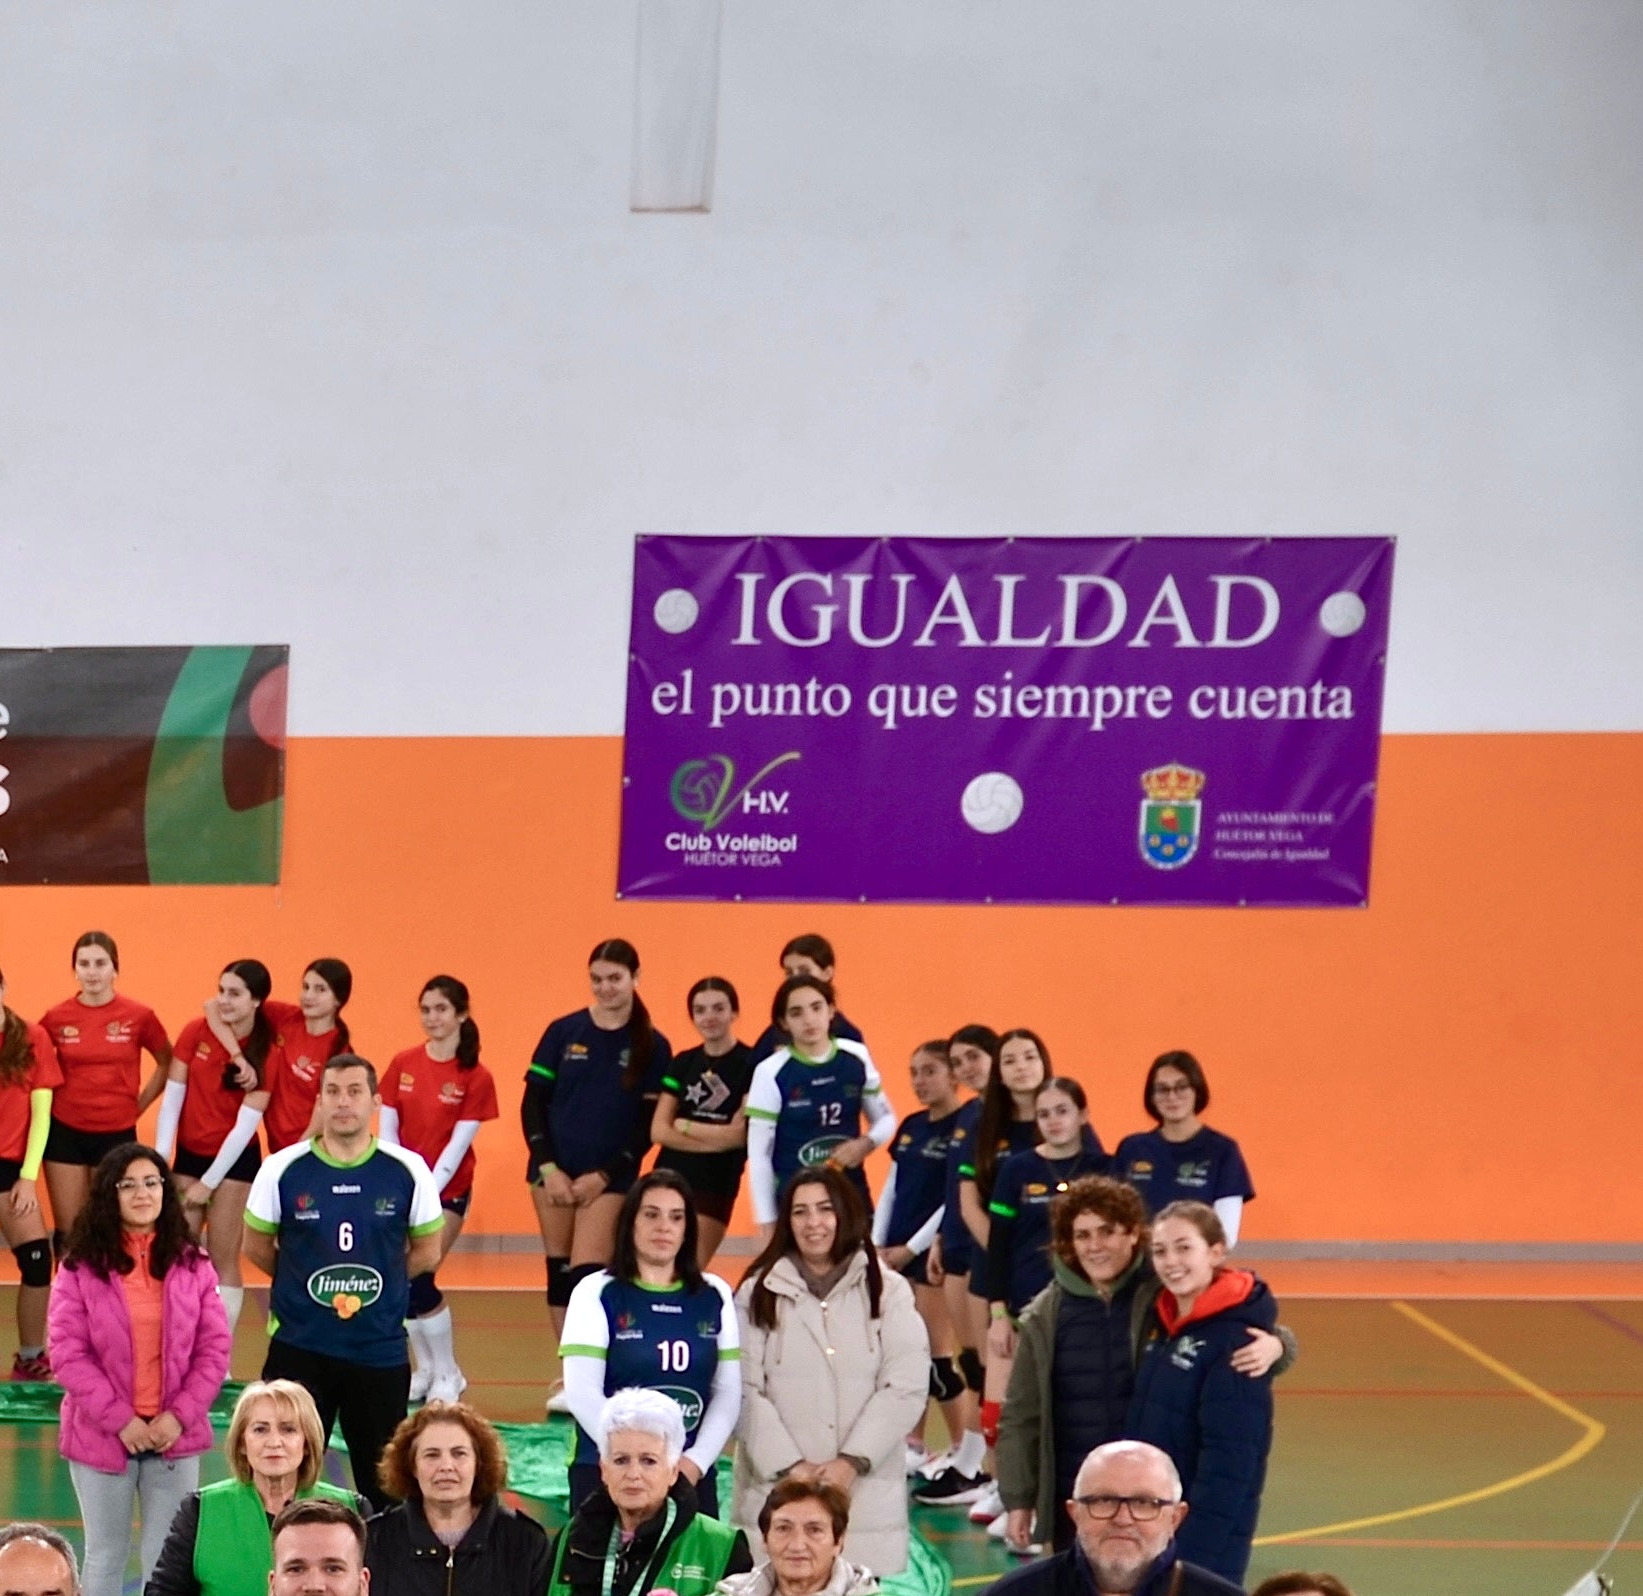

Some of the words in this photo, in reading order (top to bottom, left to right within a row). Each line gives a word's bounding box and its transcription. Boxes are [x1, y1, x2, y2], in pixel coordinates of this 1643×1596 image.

[730, 572, 1281, 649] IGUALDAD
[651, 669, 695, 716] el
[710, 677, 853, 728] punto
[867, 682, 957, 731] que
[973, 671, 1172, 731] siempre
[1188, 679, 1354, 720] cuenta
[665, 832, 712, 851] Club
[716, 832, 798, 852] Voleibol
[741, 853, 782, 866] VEGA
[818, 1101, 843, 1126] 12
[338, 1221, 354, 1252] 6
[316, 1274, 379, 1296] Jiménez
[657, 1339, 690, 1372] 10
